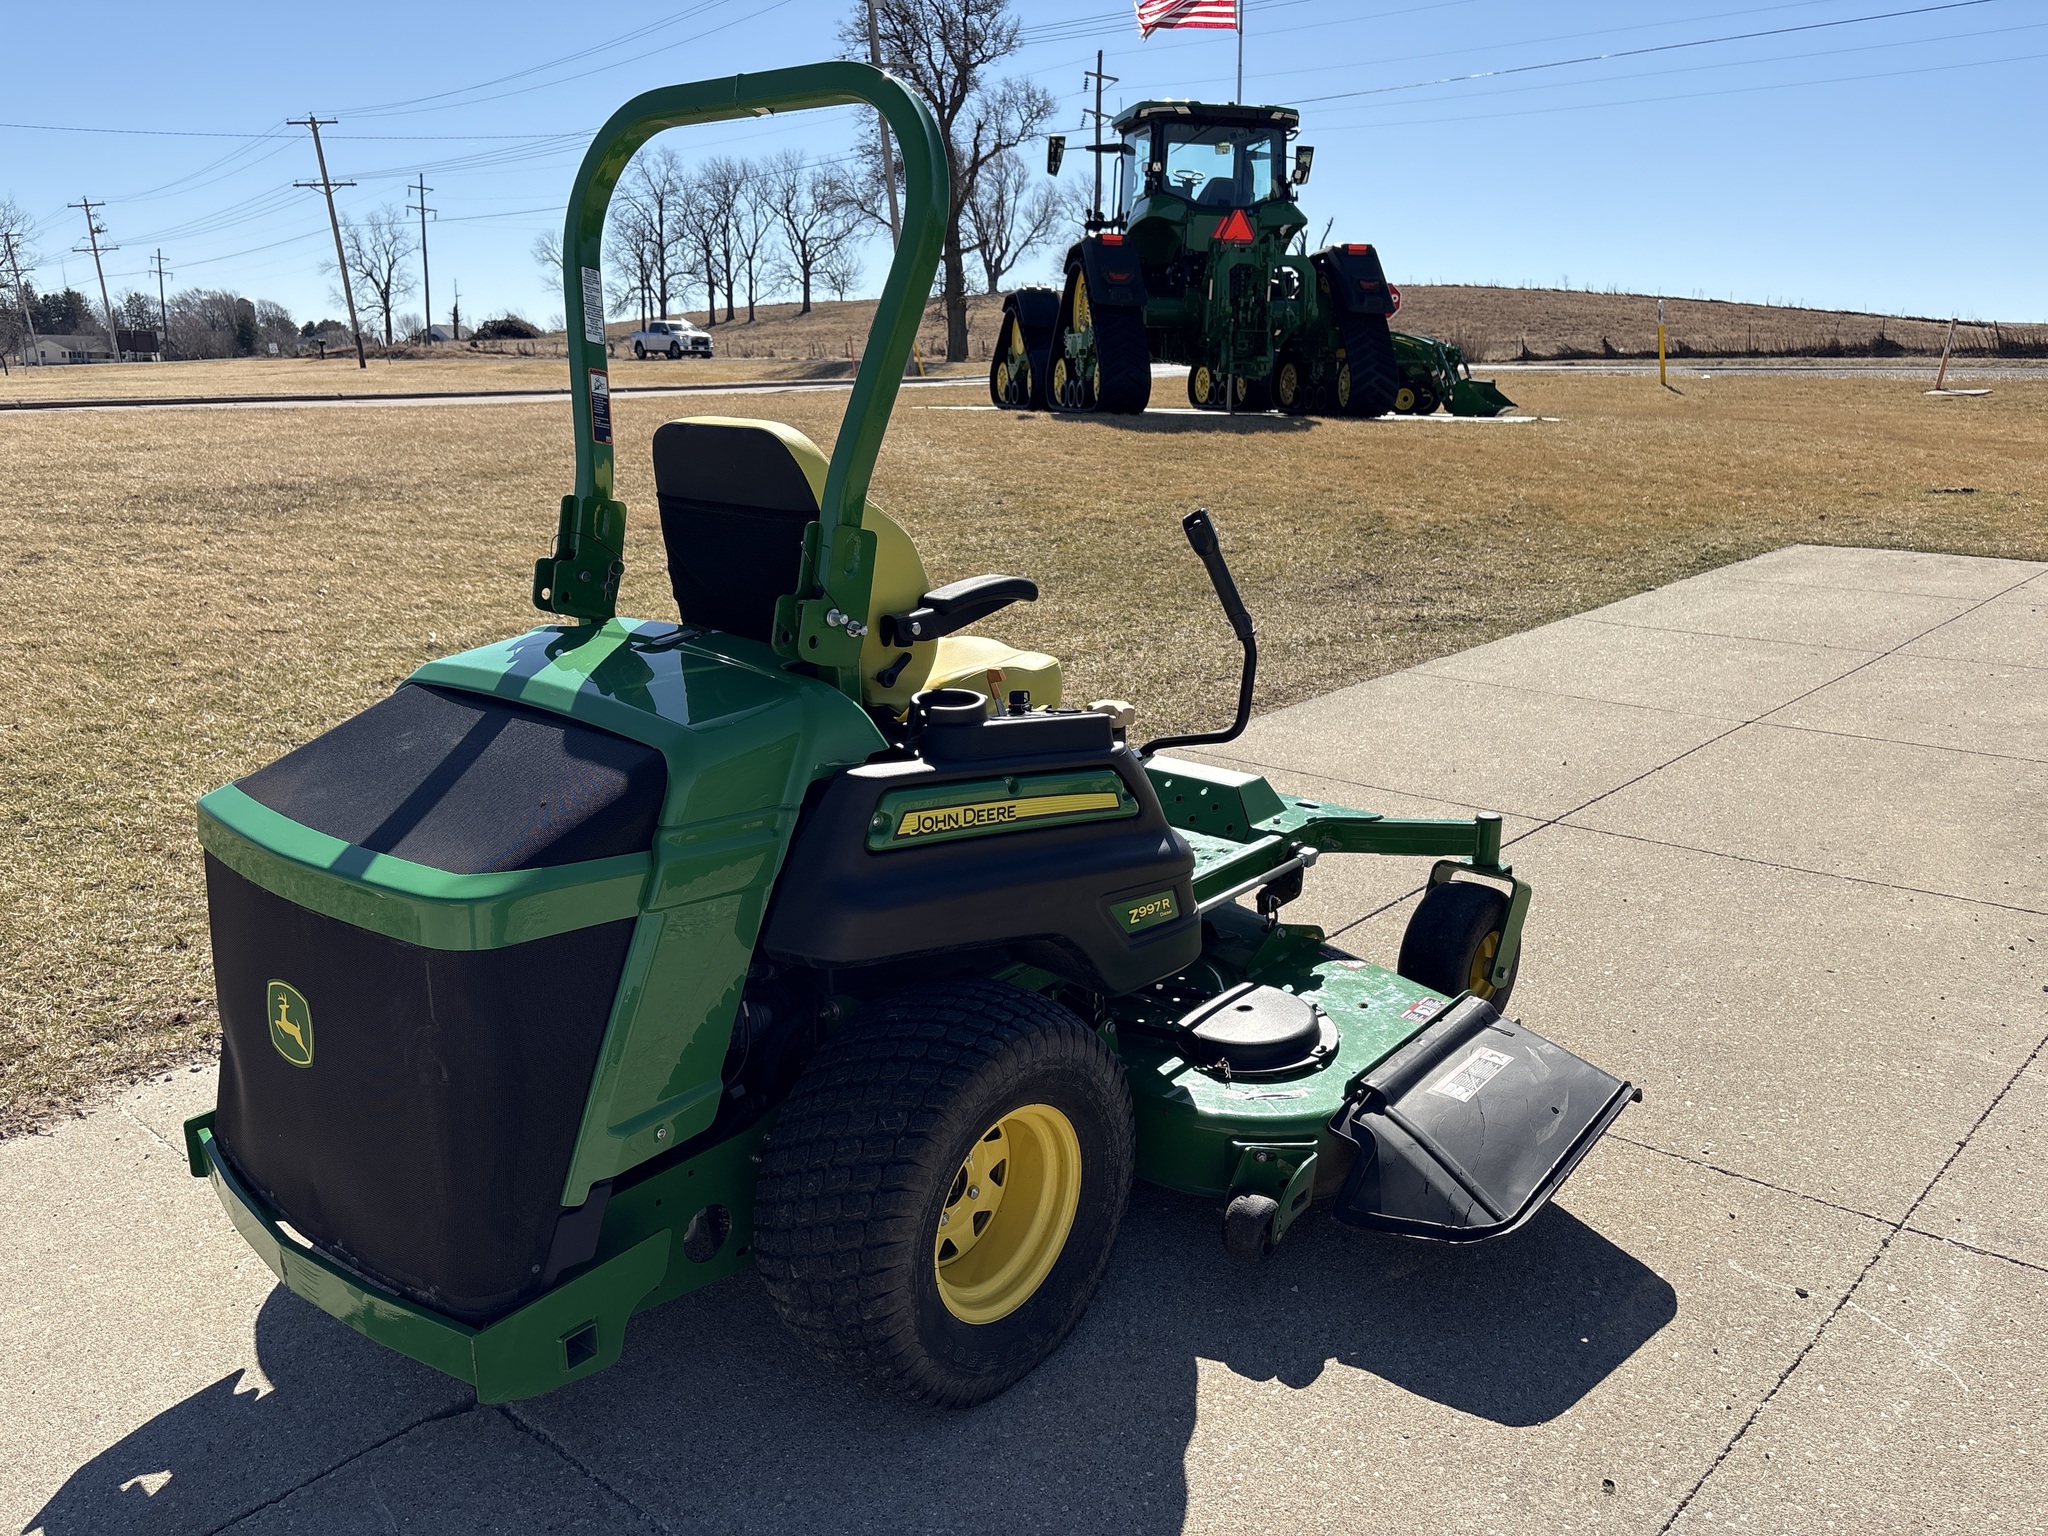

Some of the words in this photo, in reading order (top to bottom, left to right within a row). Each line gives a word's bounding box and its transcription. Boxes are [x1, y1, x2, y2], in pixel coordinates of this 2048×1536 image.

[911, 812, 959, 833] JOHN
[963, 804, 1017, 825] DEERE
[1128, 898, 1171, 924] Z997R
